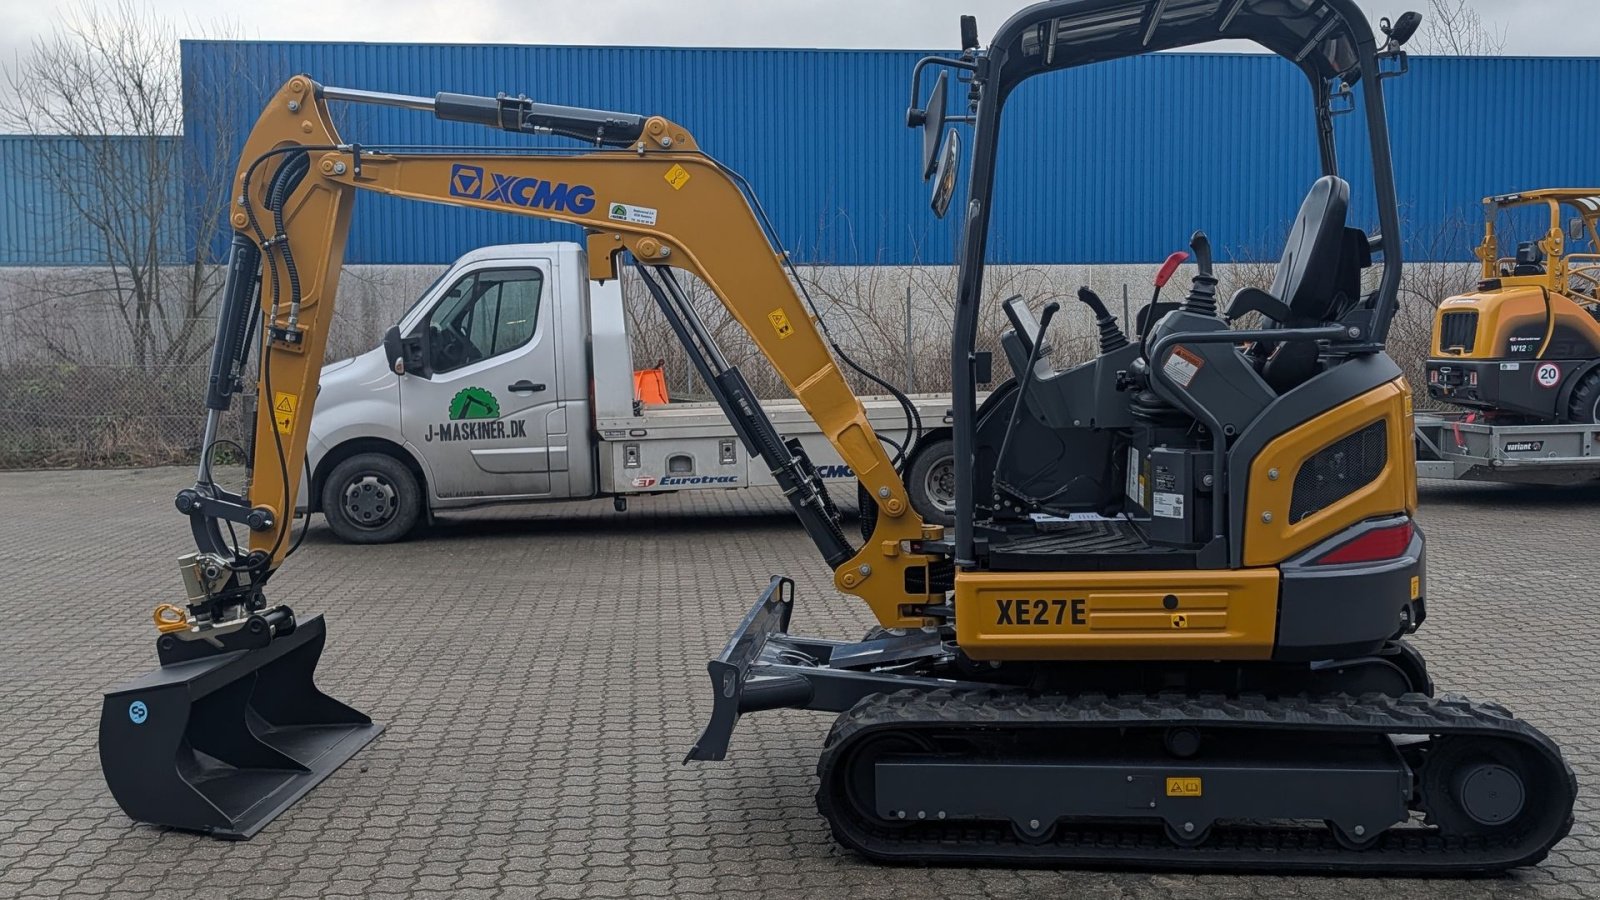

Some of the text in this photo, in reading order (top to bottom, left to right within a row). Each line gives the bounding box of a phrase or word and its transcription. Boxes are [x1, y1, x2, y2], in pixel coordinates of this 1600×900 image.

[480, 173, 596, 215] XCMG
[1511, 344, 1527, 352] W12
[1540, 368, 1557, 379] 20
[425, 420, 527, 442] J-MASKINER.DK
[1507, 442, 1532, 451] variant
[813, 465, 856, 478] CMG
[659, 475, 738, 486] Eurotrac
[996, 599, 1086, 625] XE27E
